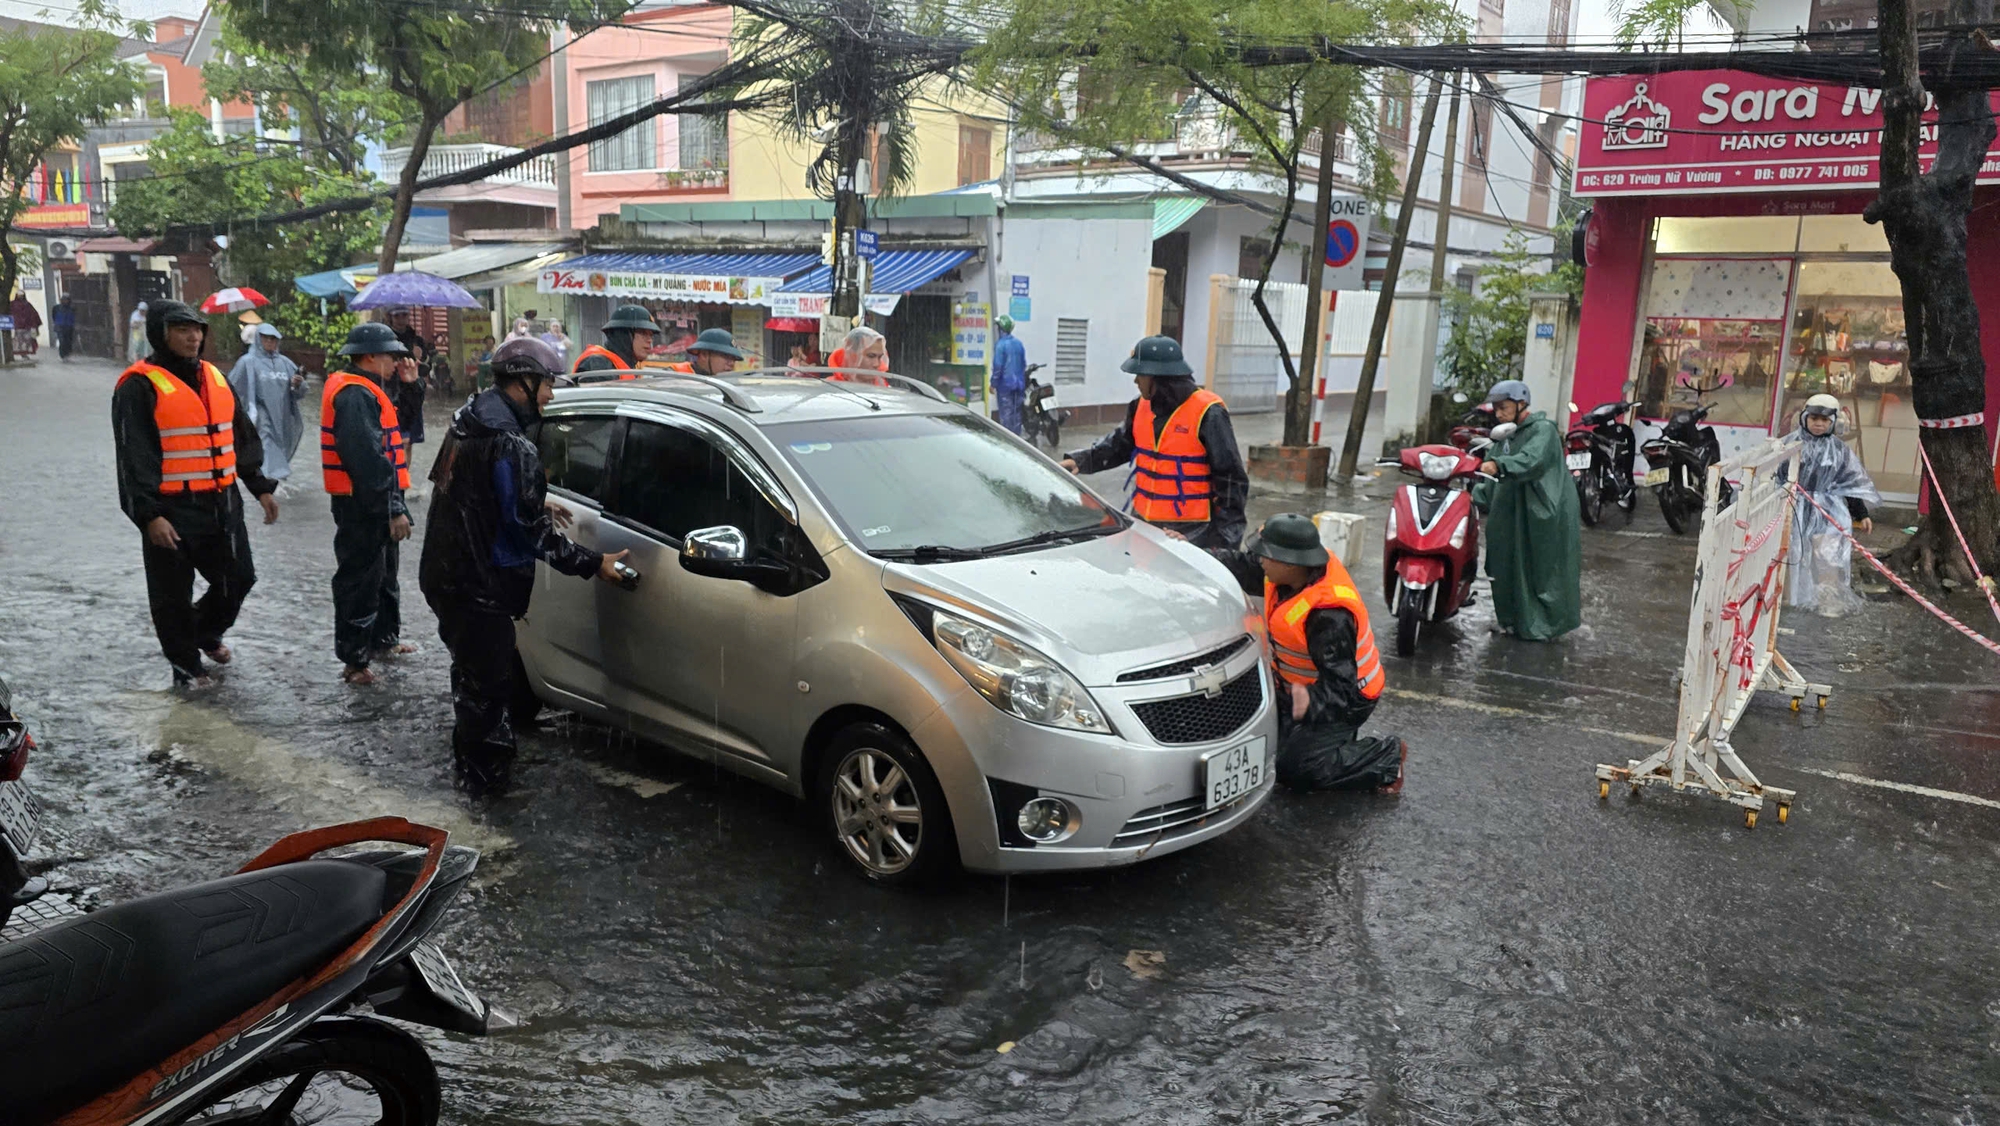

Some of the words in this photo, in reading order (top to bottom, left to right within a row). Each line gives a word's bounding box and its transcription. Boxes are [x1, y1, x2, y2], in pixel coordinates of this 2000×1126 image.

[1698, 83, 1818, 124] Sara
[1720, 130, 1787, 151] HÀNG
[1603, 174, 1624, 185] 620
[1629, 172, 1661, 185] Trưng
[1665, 170, 1681, 183] Nữ
[1686, 171, 1721, 183] Vương
[1779, 166, 1812, 179] 0977
[1818, 165, 1838, 178] 741
[1843, 164, 1868, 177] 005
[1331, 200, 1367, 215] ONE
[860, 232, 875, 245] K626
[624, 274, 637, 287] CHẢ
[638, 275, 647, 288] CÁ
[664, 275, 686, 291] QUẢNG
[693, 277, 712, 291] NƯỚC
[713, 278, 727, 292] MÍA
[1225, 746, 1249, 773] 43A
[1214, 765, 1259, 803] 633.78
[11, 795, 41, 846] 012.88
[150, 1033, 241, 1099] EXCITER
